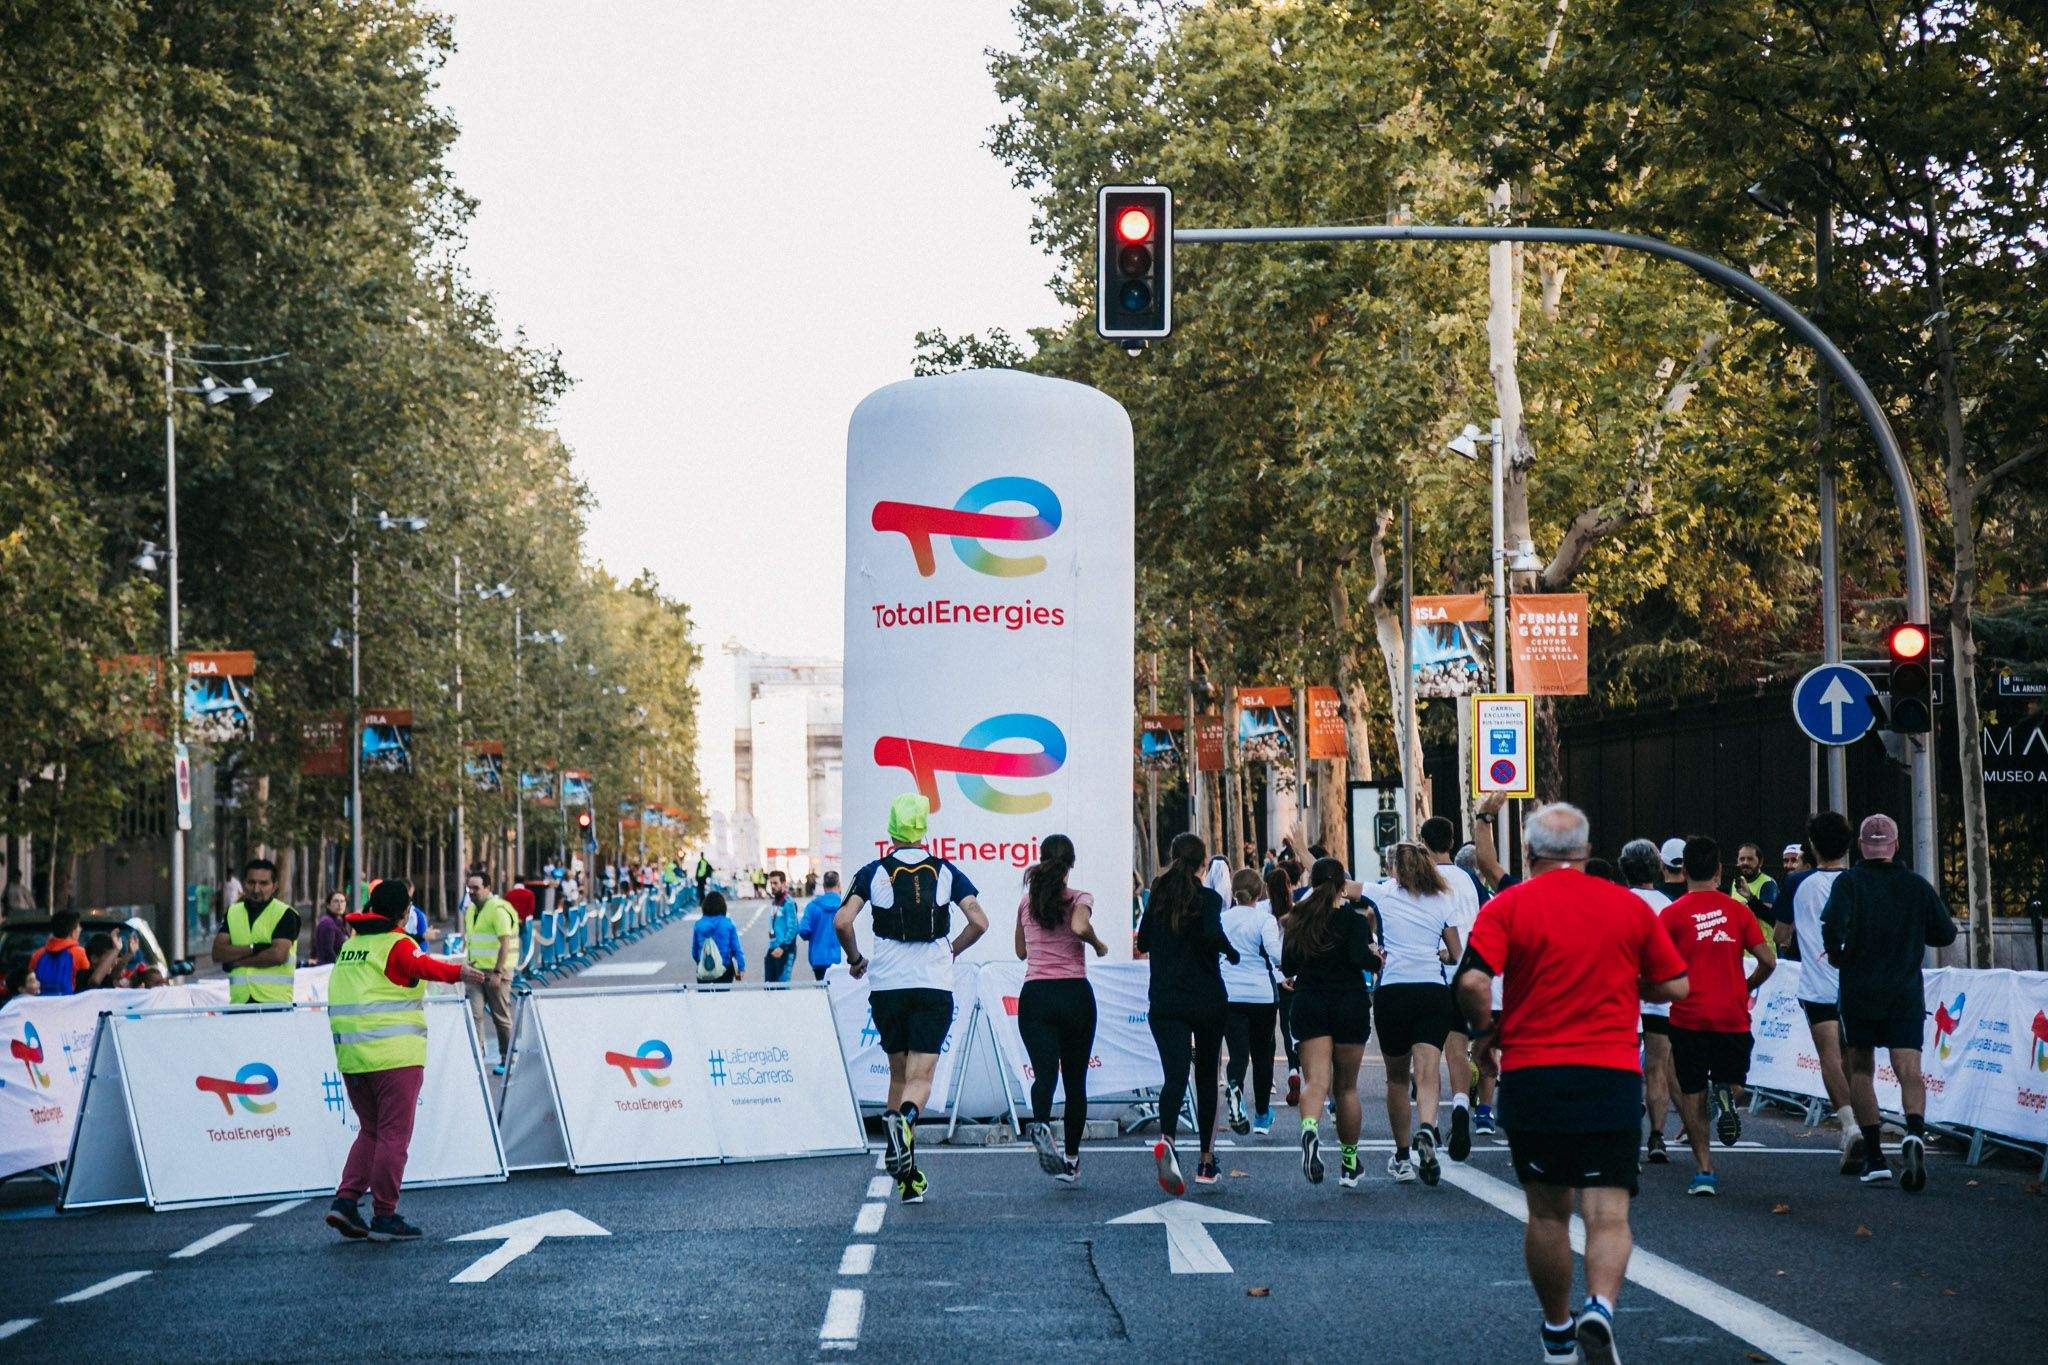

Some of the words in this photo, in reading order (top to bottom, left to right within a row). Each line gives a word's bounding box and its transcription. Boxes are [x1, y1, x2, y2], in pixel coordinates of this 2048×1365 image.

[872, 600, 1065, 630] TotalEnergies
[1414, 607, 1448, 620] ISLA
[1518, 611, 1579, 625] FERNÁN
[1518, 624, 1579, 637] GÓMEZ
[1535, 653, 1547, 661] LA
[1551, 653, 1579, 661] VILLA
[188, 662, 218, 674] ISLA
[2012, 685, 2021, 693] LA
[1241, 696, 1265, 706] ISLA
[1984, 770, 2034, 782] MUSEO
[1696, 929, 1714, 941] por
[615, 1098, 684, 1113] TotalEnergies
[206, 1125, 292, 1142] TotalEnergies
